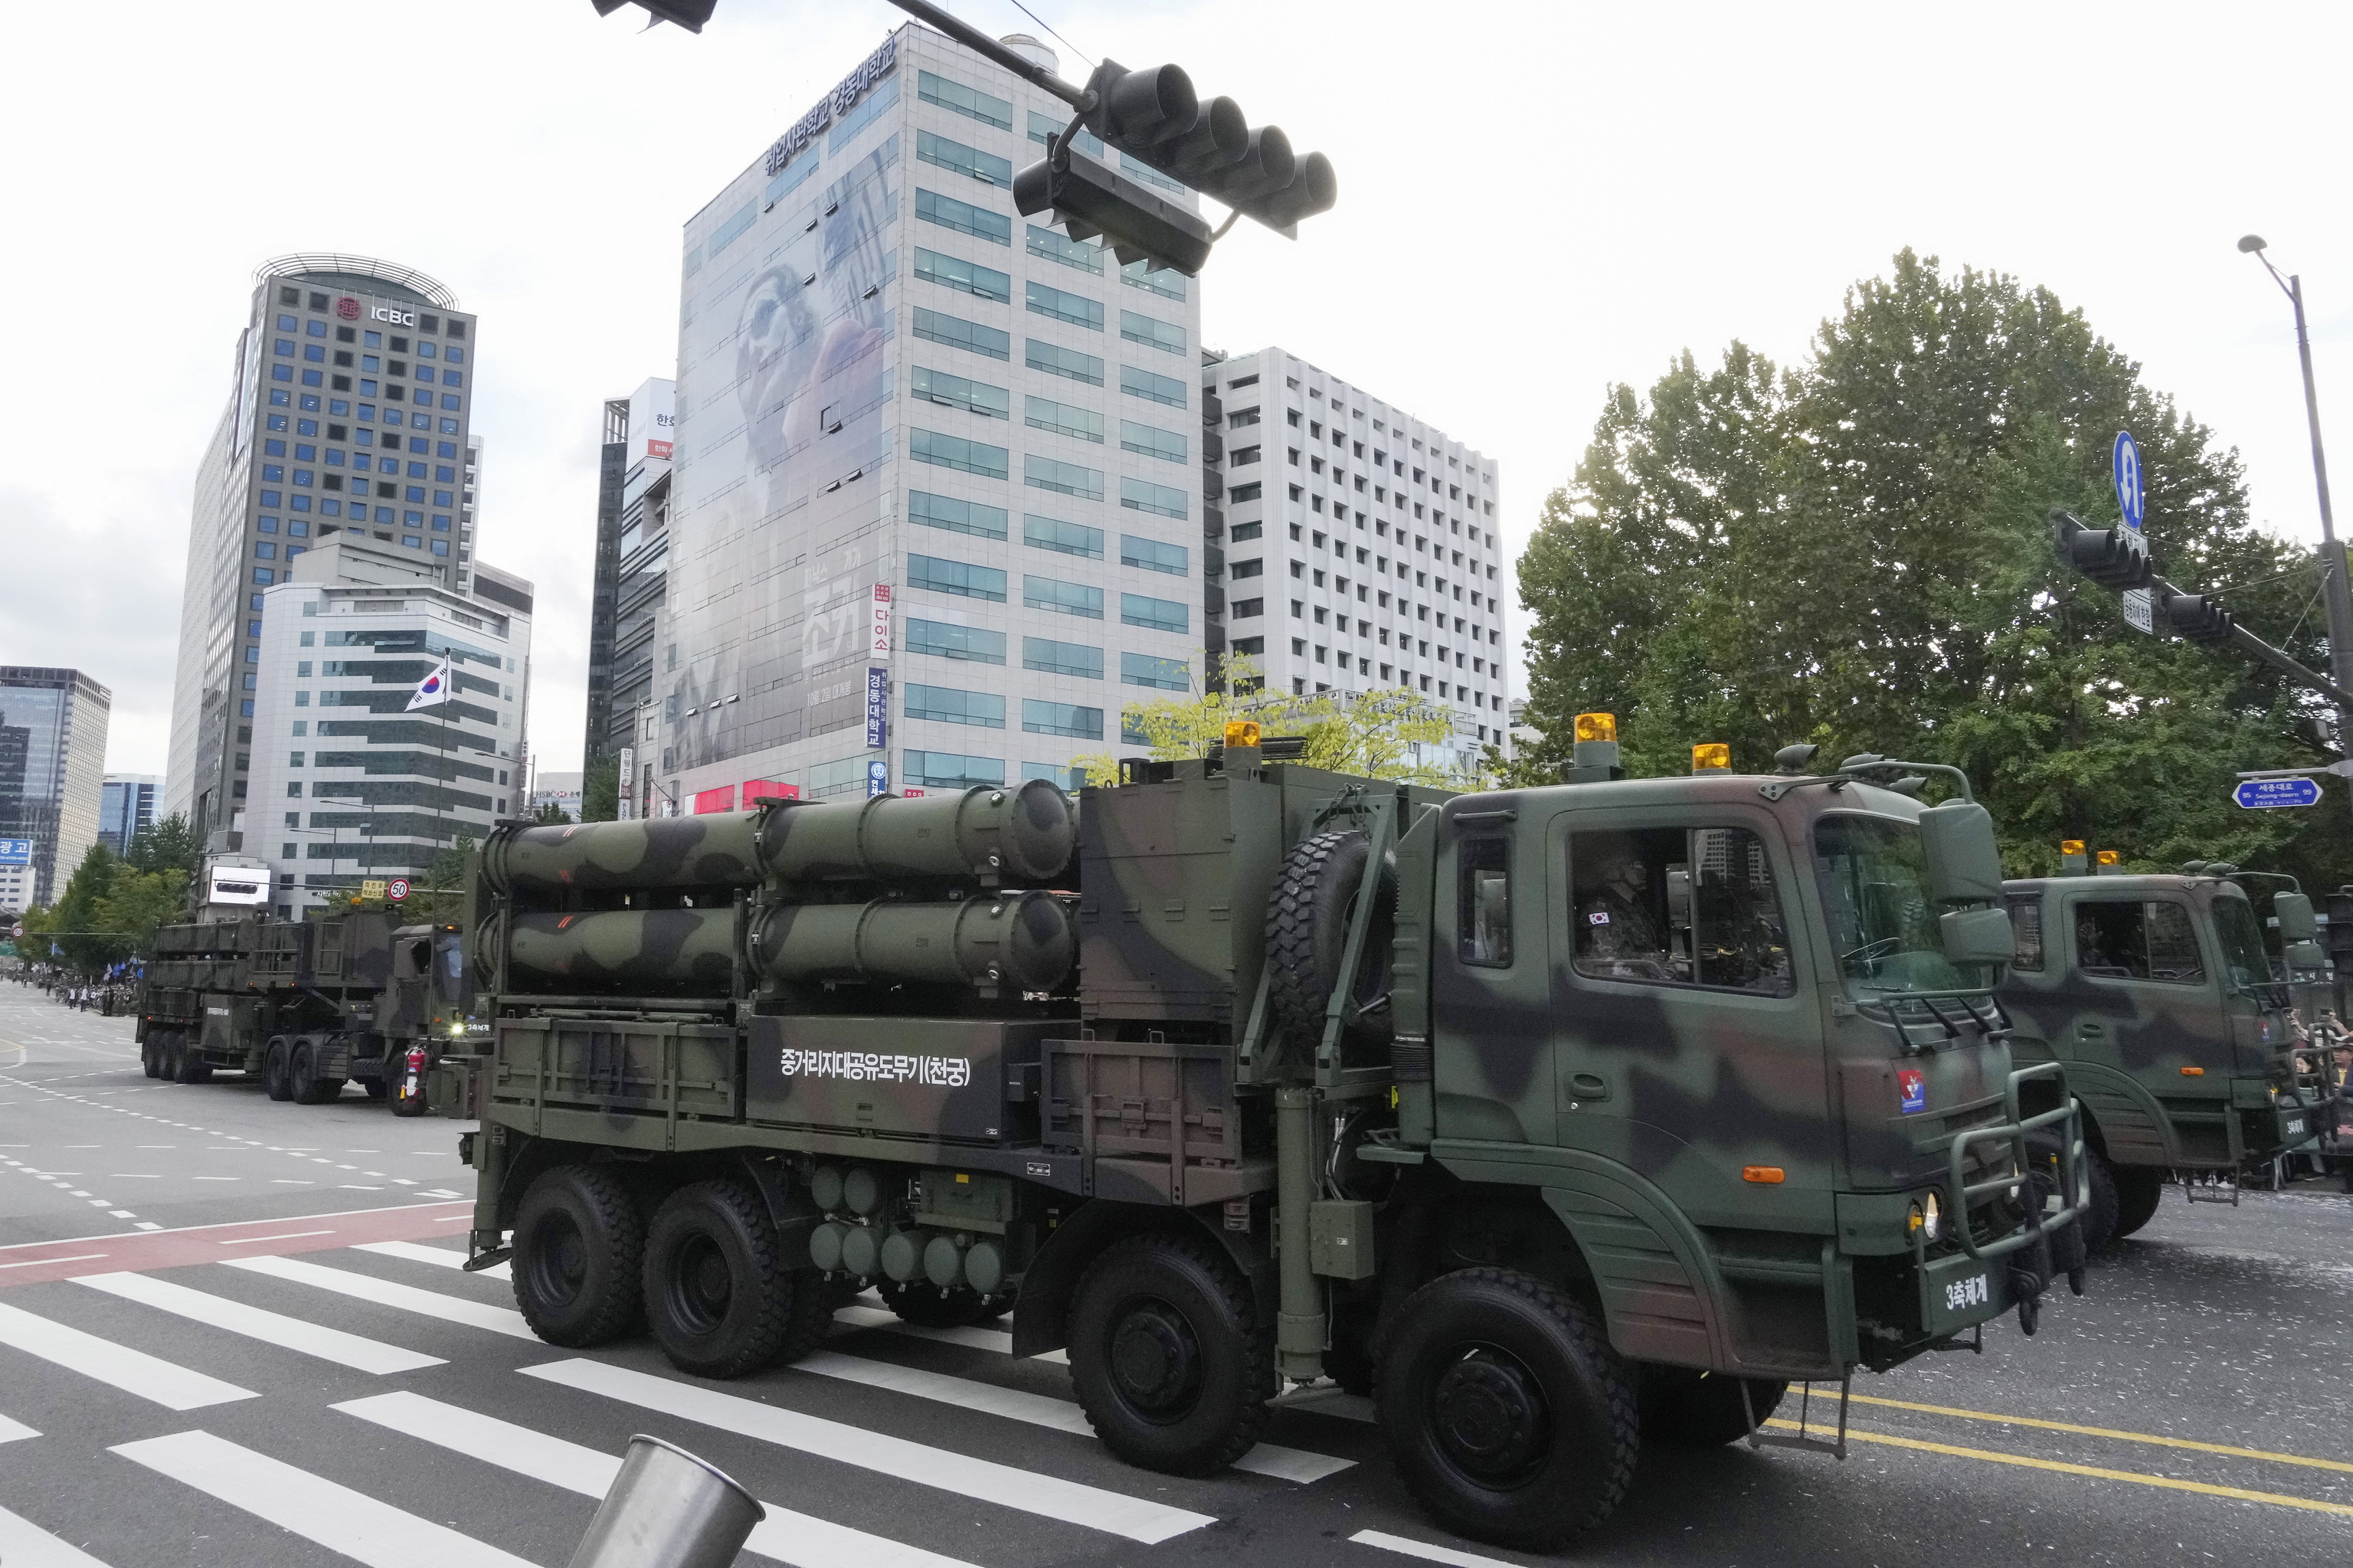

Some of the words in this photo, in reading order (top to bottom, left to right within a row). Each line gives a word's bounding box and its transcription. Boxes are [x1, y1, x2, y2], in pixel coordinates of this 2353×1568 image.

[765, 96, 830, 176] 취업사관학교
[834, 36, 895, 115] 경동대학교
[371, 306, 414, 327] ICBC
[875, 609, 889, 650] 다이소
[807, 690, 820, 707] 10월
[821, 686, 831, 703] 2일
[832, 680, 851, 699] 대개봉
[869, 675, 881, 745] 경동대학교
[2259, 783, 2294, 792] 세종대로
[0, 841, 28, 854] 광고
[392, 884, 405, 895] 50
[781, 1048, 970, 1087] 중거리지대공유도무기(천궁)
[1946, 1273, 1988, 1311] 3축체계
